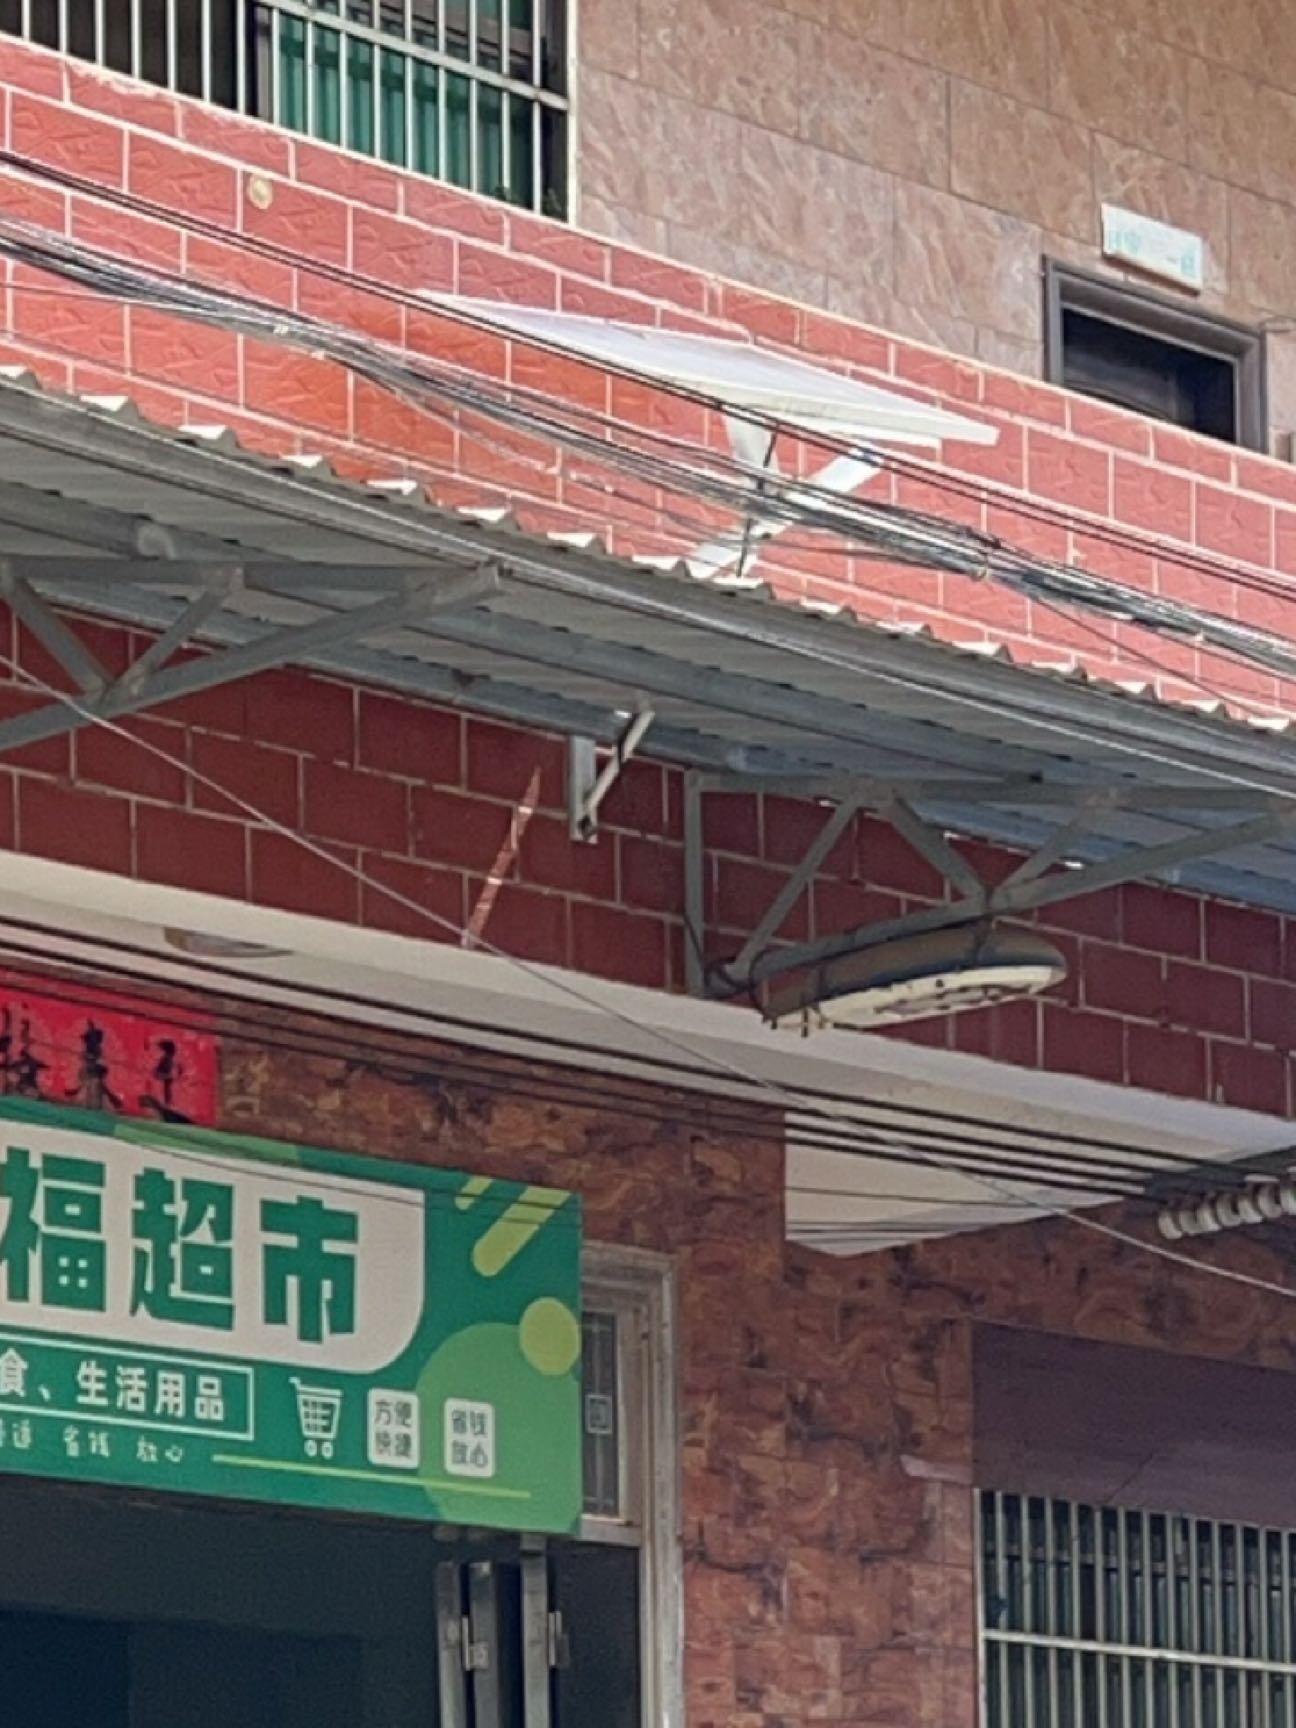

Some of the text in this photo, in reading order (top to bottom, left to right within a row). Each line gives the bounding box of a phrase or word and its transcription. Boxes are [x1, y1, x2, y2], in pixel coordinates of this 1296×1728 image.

[374, 1399, 412, 1429] 方便
[451, 1409, 489, 1436] 省钱
[375, 1431, 413, 1460] 快捷
[451, 1440, 489, 1468] 放心
